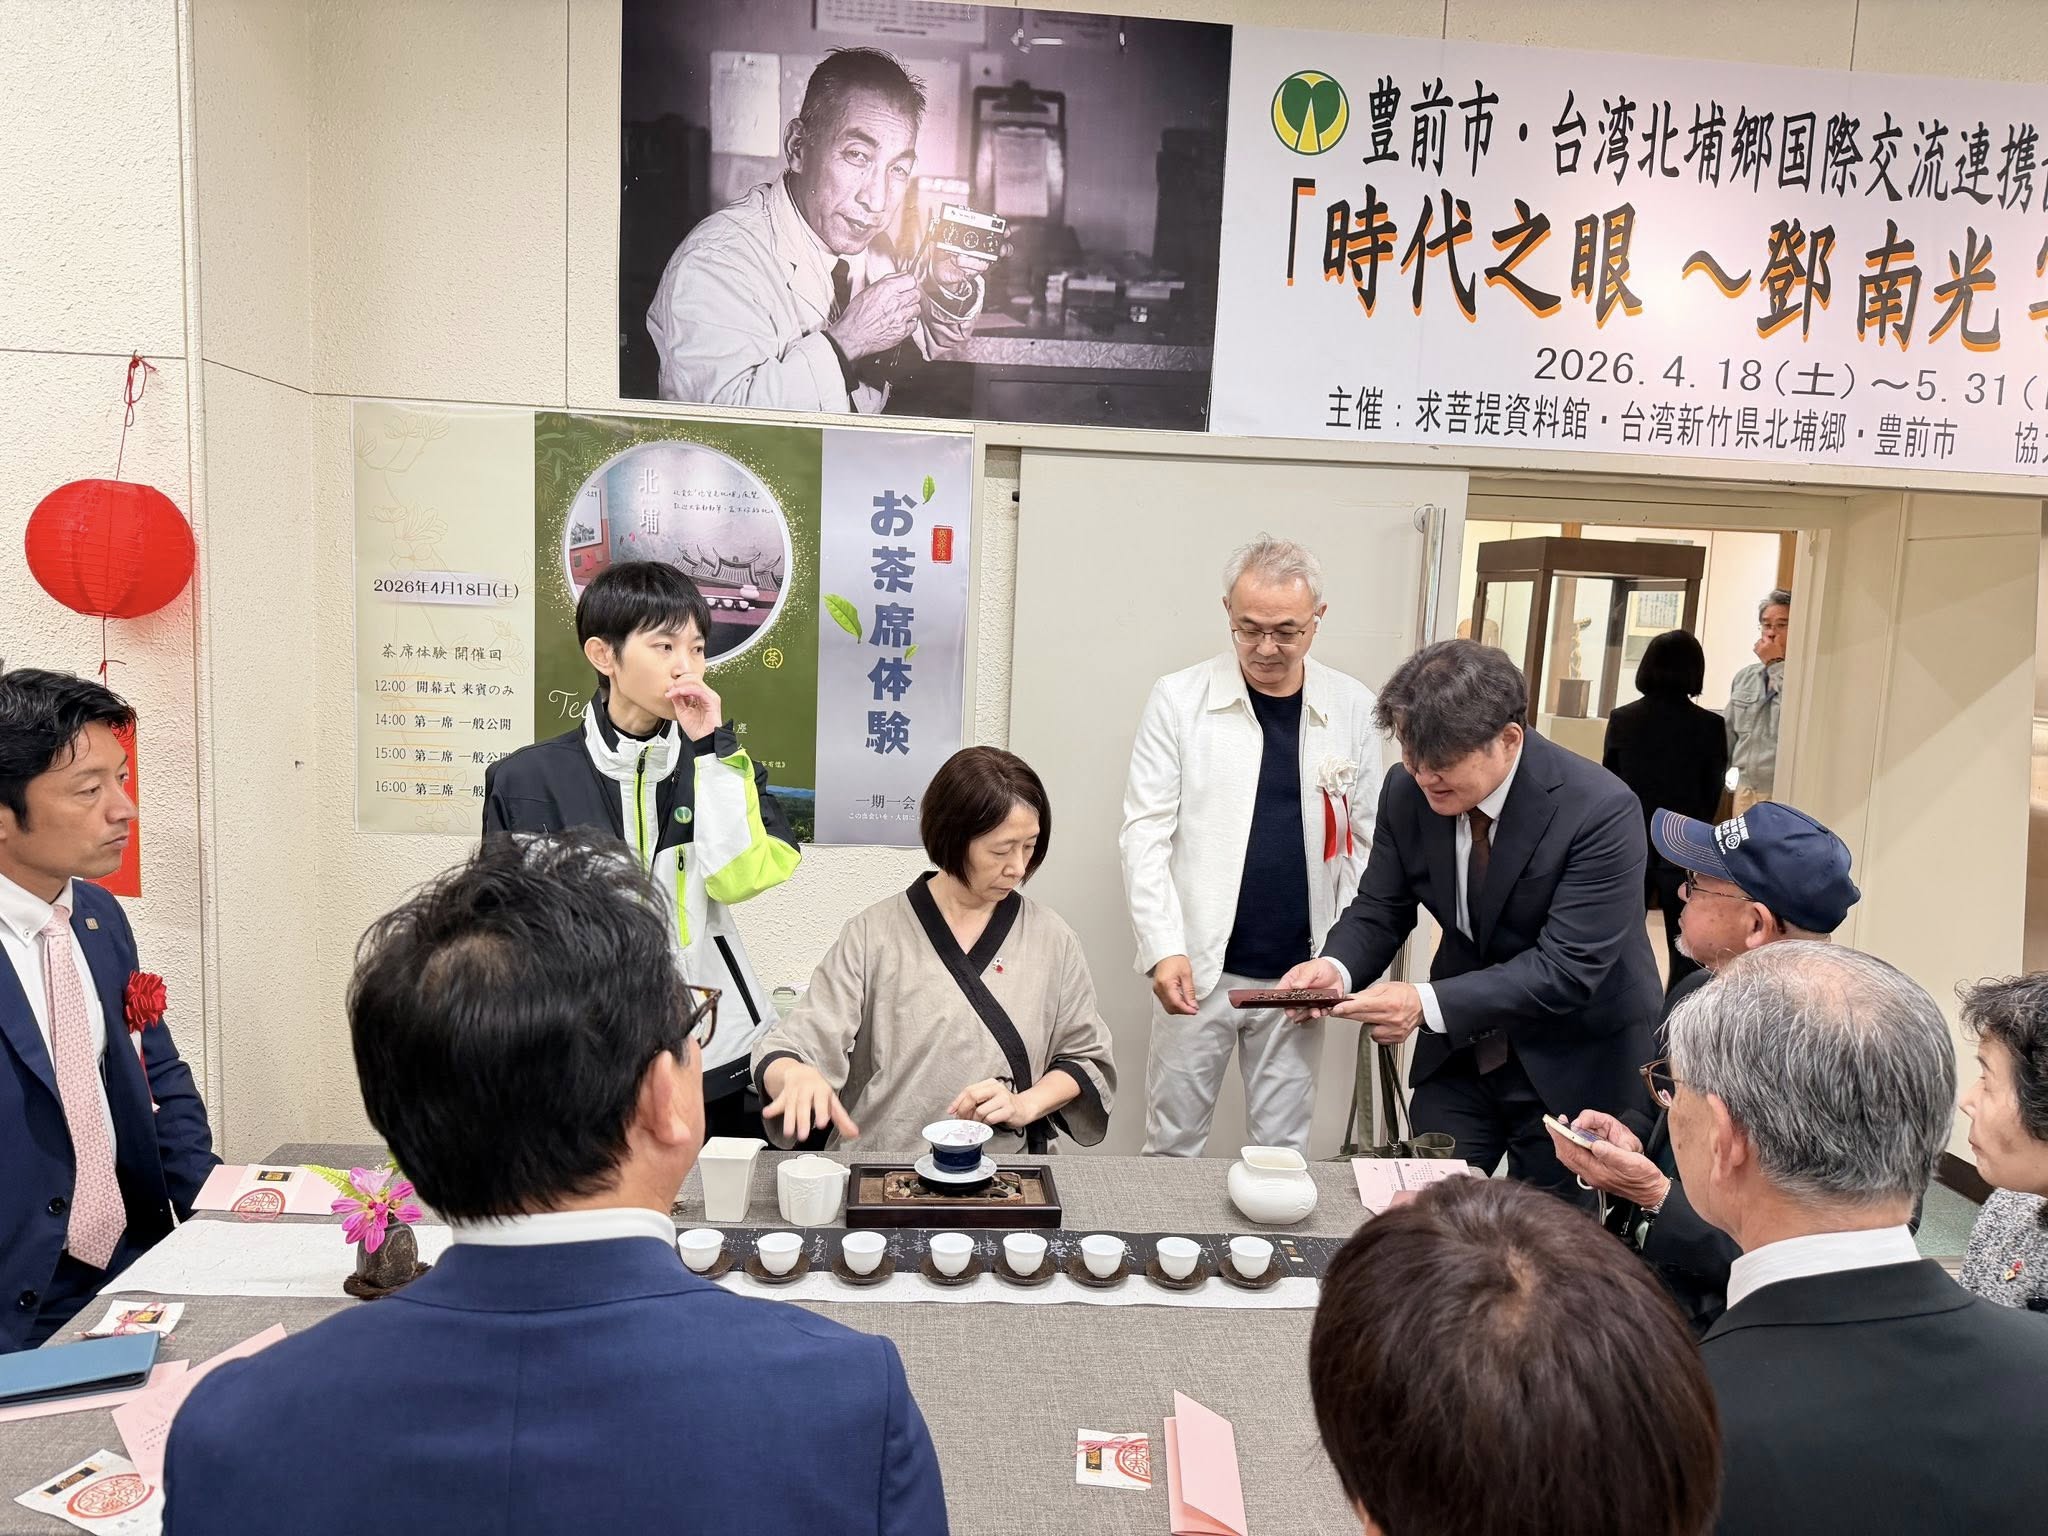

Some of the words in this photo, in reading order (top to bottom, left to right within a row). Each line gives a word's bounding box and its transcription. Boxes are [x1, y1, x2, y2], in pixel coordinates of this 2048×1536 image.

[1363, 74, 2048, 214] 豊前市・台湾北埔郷国際交流連携
[639, 467, 659, 534] 北埔
[373, 578, 519, 600] 2026年4月18日(土)
[866, 489, 918, 756] お茶席体験
[381, 643, 448, 661] 茶席体験
[375, 679, 406, 693] 12:00
[416, 680, 457, 695] 開幕式
[461, 682, 514, 696] 来賓のみ
[375, 713, 406, 726] 14:00
[414, 715, 453, 729] 第一席
[458, 717, 512, 731] 一般公開
[375, 746, 407, 760] 15:00
[415, 749, 453, 763] 第二席
[375, 780, 407, 793] 16:00
[415, 783, 454, 797] 第三席
[855, 794, 916, 810] 一期一会
